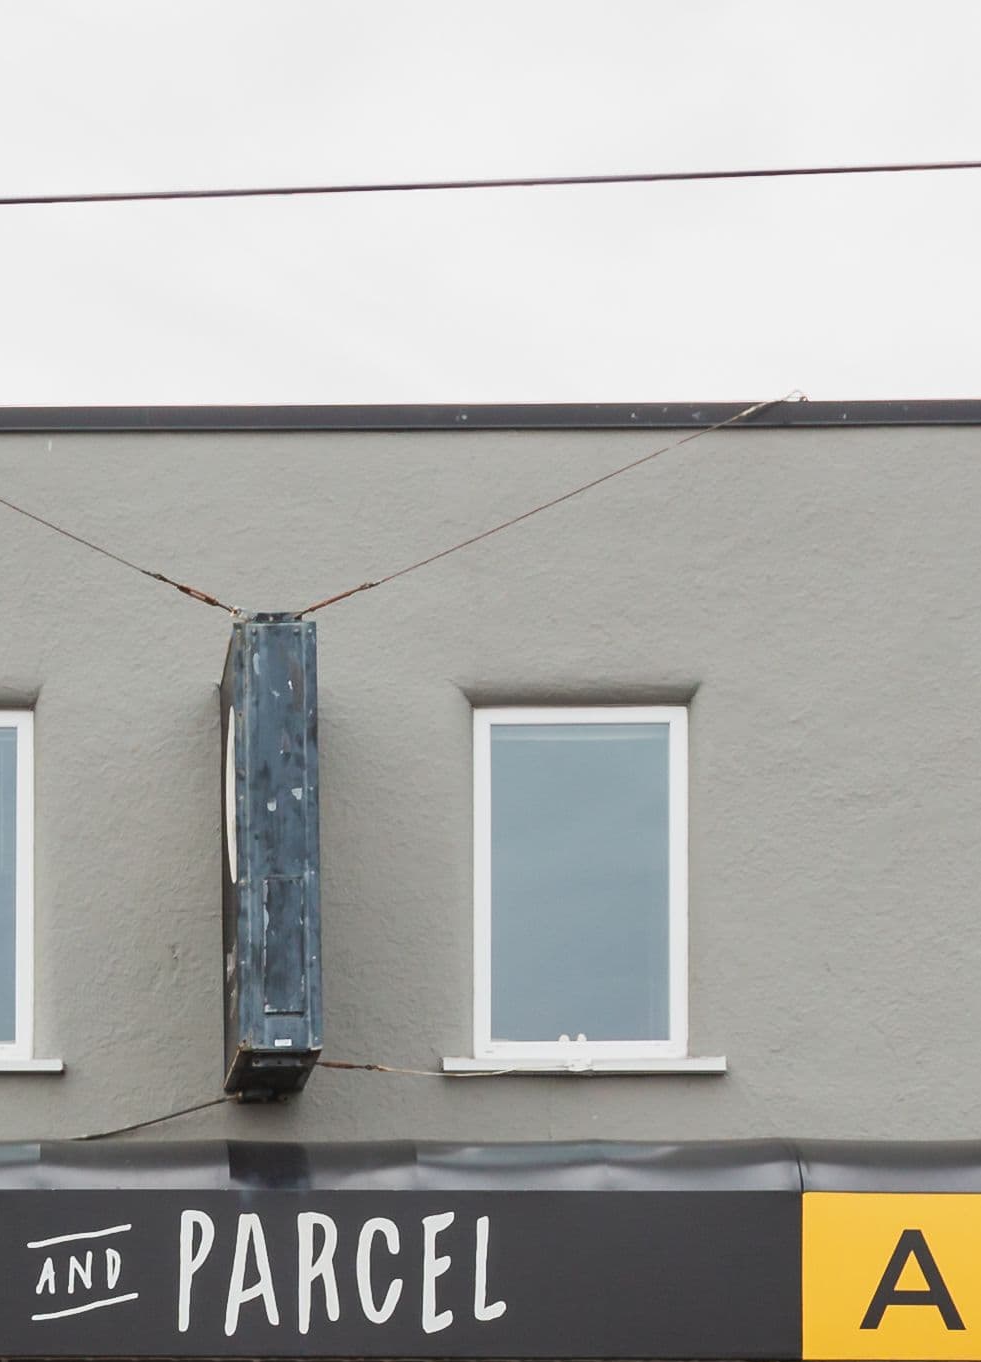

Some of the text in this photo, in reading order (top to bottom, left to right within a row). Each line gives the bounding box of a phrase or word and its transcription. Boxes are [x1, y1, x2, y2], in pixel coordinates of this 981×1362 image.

[35, 1247, 122, 1295] AND
[177, 1209, 507, 1336] PARCEL
[860, 1229, 967, 1331] A
